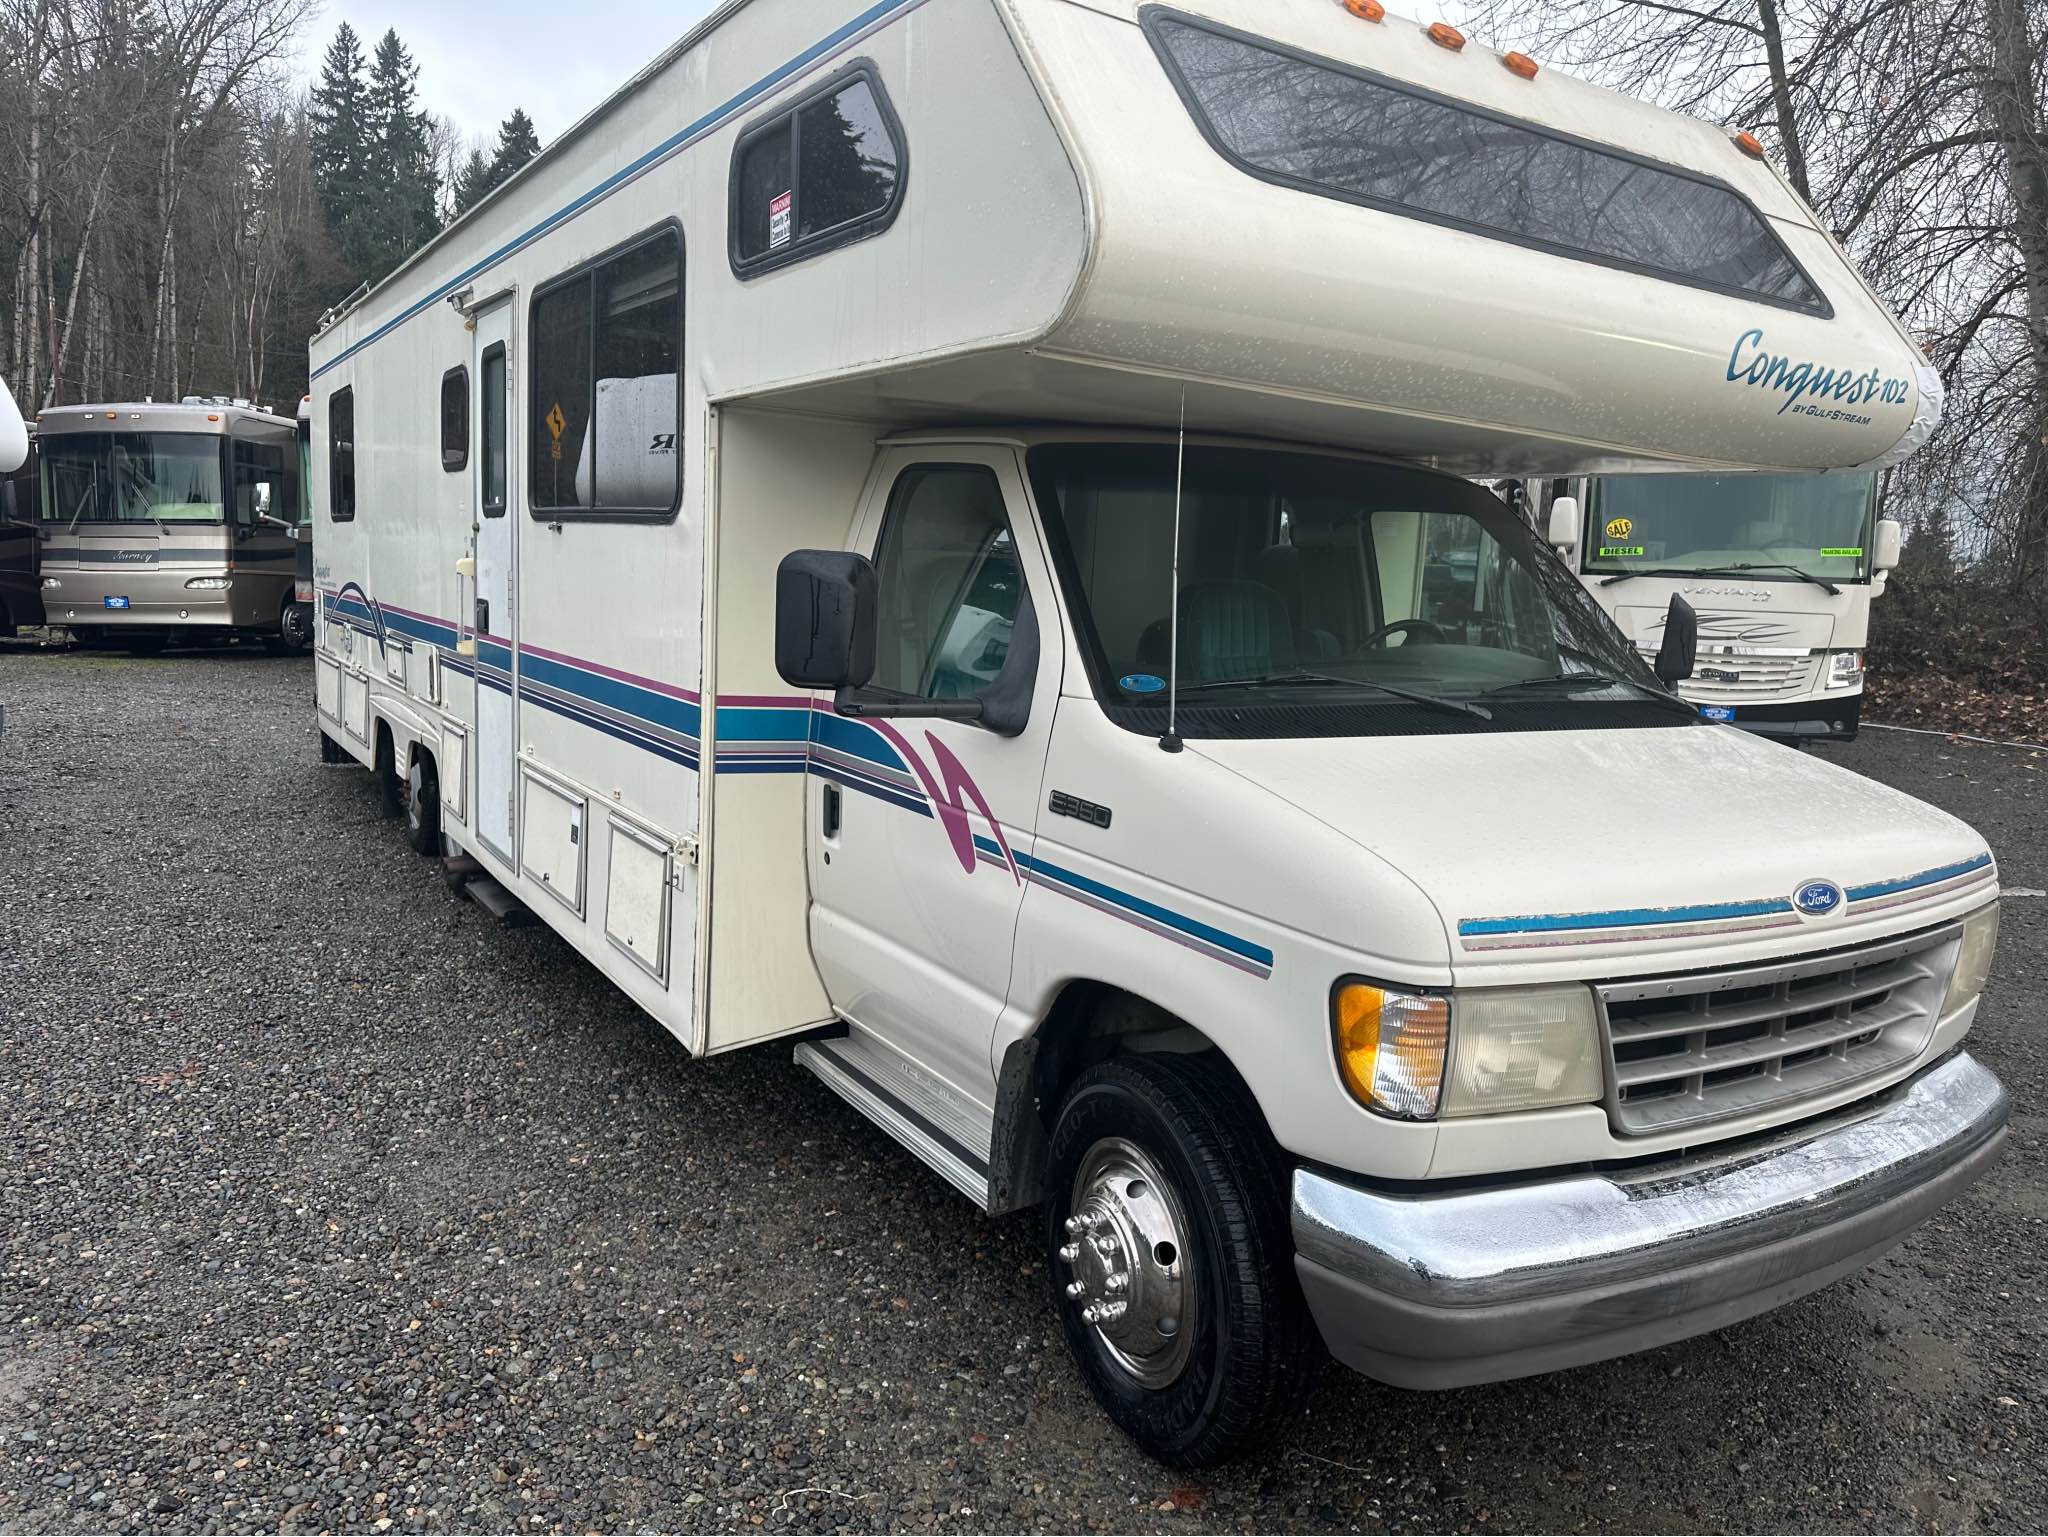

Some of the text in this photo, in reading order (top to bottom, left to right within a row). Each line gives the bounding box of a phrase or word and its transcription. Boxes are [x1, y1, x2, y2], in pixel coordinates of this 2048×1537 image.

[1726, 328, 1908, 416] Conquest 102
[1792, 404, 1806, 415] BY
[1608, 521, 1631, 536] SALE
[112, 550, 152, 563] Journey
[1603, 547, 1640, 555] DIESEL
[1682, 586, 1772, 597] VENTANA
[1807, 889, 1832, 905] Ford
